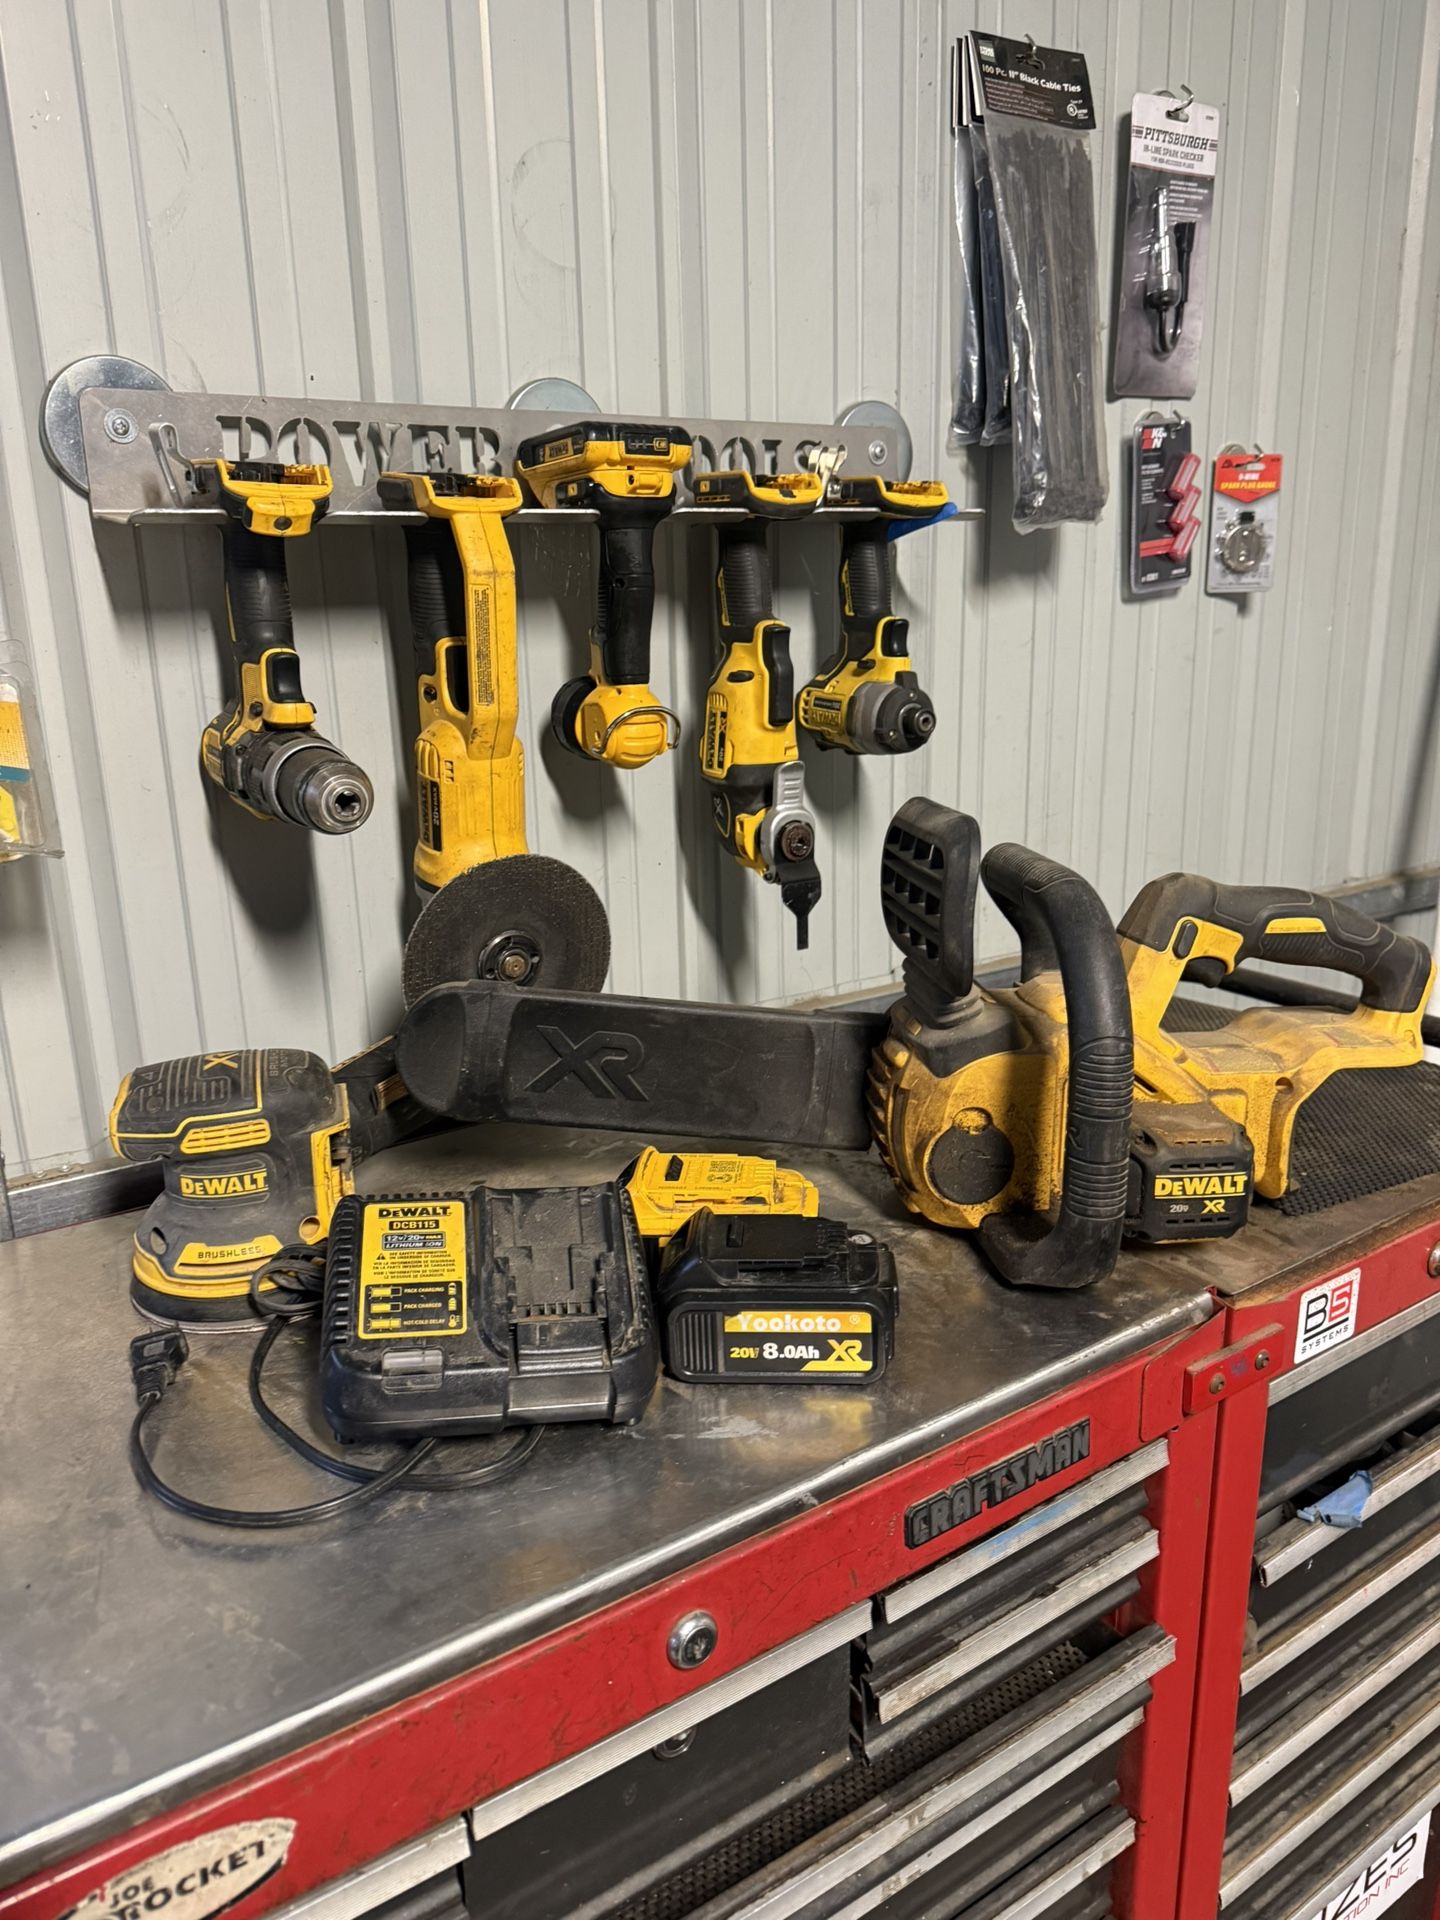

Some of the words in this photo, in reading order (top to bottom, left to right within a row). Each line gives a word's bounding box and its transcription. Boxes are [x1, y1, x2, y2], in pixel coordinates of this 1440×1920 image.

[982, 63, 994, 74] 100
[1020, 72, 1040, 86] Black
[1040, 79, 1062, 92] Cable
[1062, 83, 1082, 93] Ties
[1144, 126, 1210, 150] PITTSBURGH
[216, 415, 500, 487] POWER
[523, 1025, 650, 1101] XR
[180, 1171, 268, 1196] DEWALT
[1154, 1175, 1248, 1196] DEWALT
[378, 1206, 451, 1218] DEWALT
[1200, 1199, 1226, 1214] XR
[392, 1220, 436, 1229] DCB115
[197, 1245, 263, 1259] BRUSHLESS
[737, 1314, 841, 1332] Yookoto
[730, 1347, 759, 1359] 20V
[762, 1342, 820, 1360] 8.0Ah
[825, 1339, 864, 1363] XR
[1301, 1324, 1349, 1355] SYSTEMS
[907, 1418, 1090, 1549] CRAFTSMAN
[107, 1840, 266, 1920] ROCKET
[1321, 1832, 1417, 1920] ZES
[1385, 1858, 1410, 1889] INC
[110, 1876, 155, 1909] JOE
